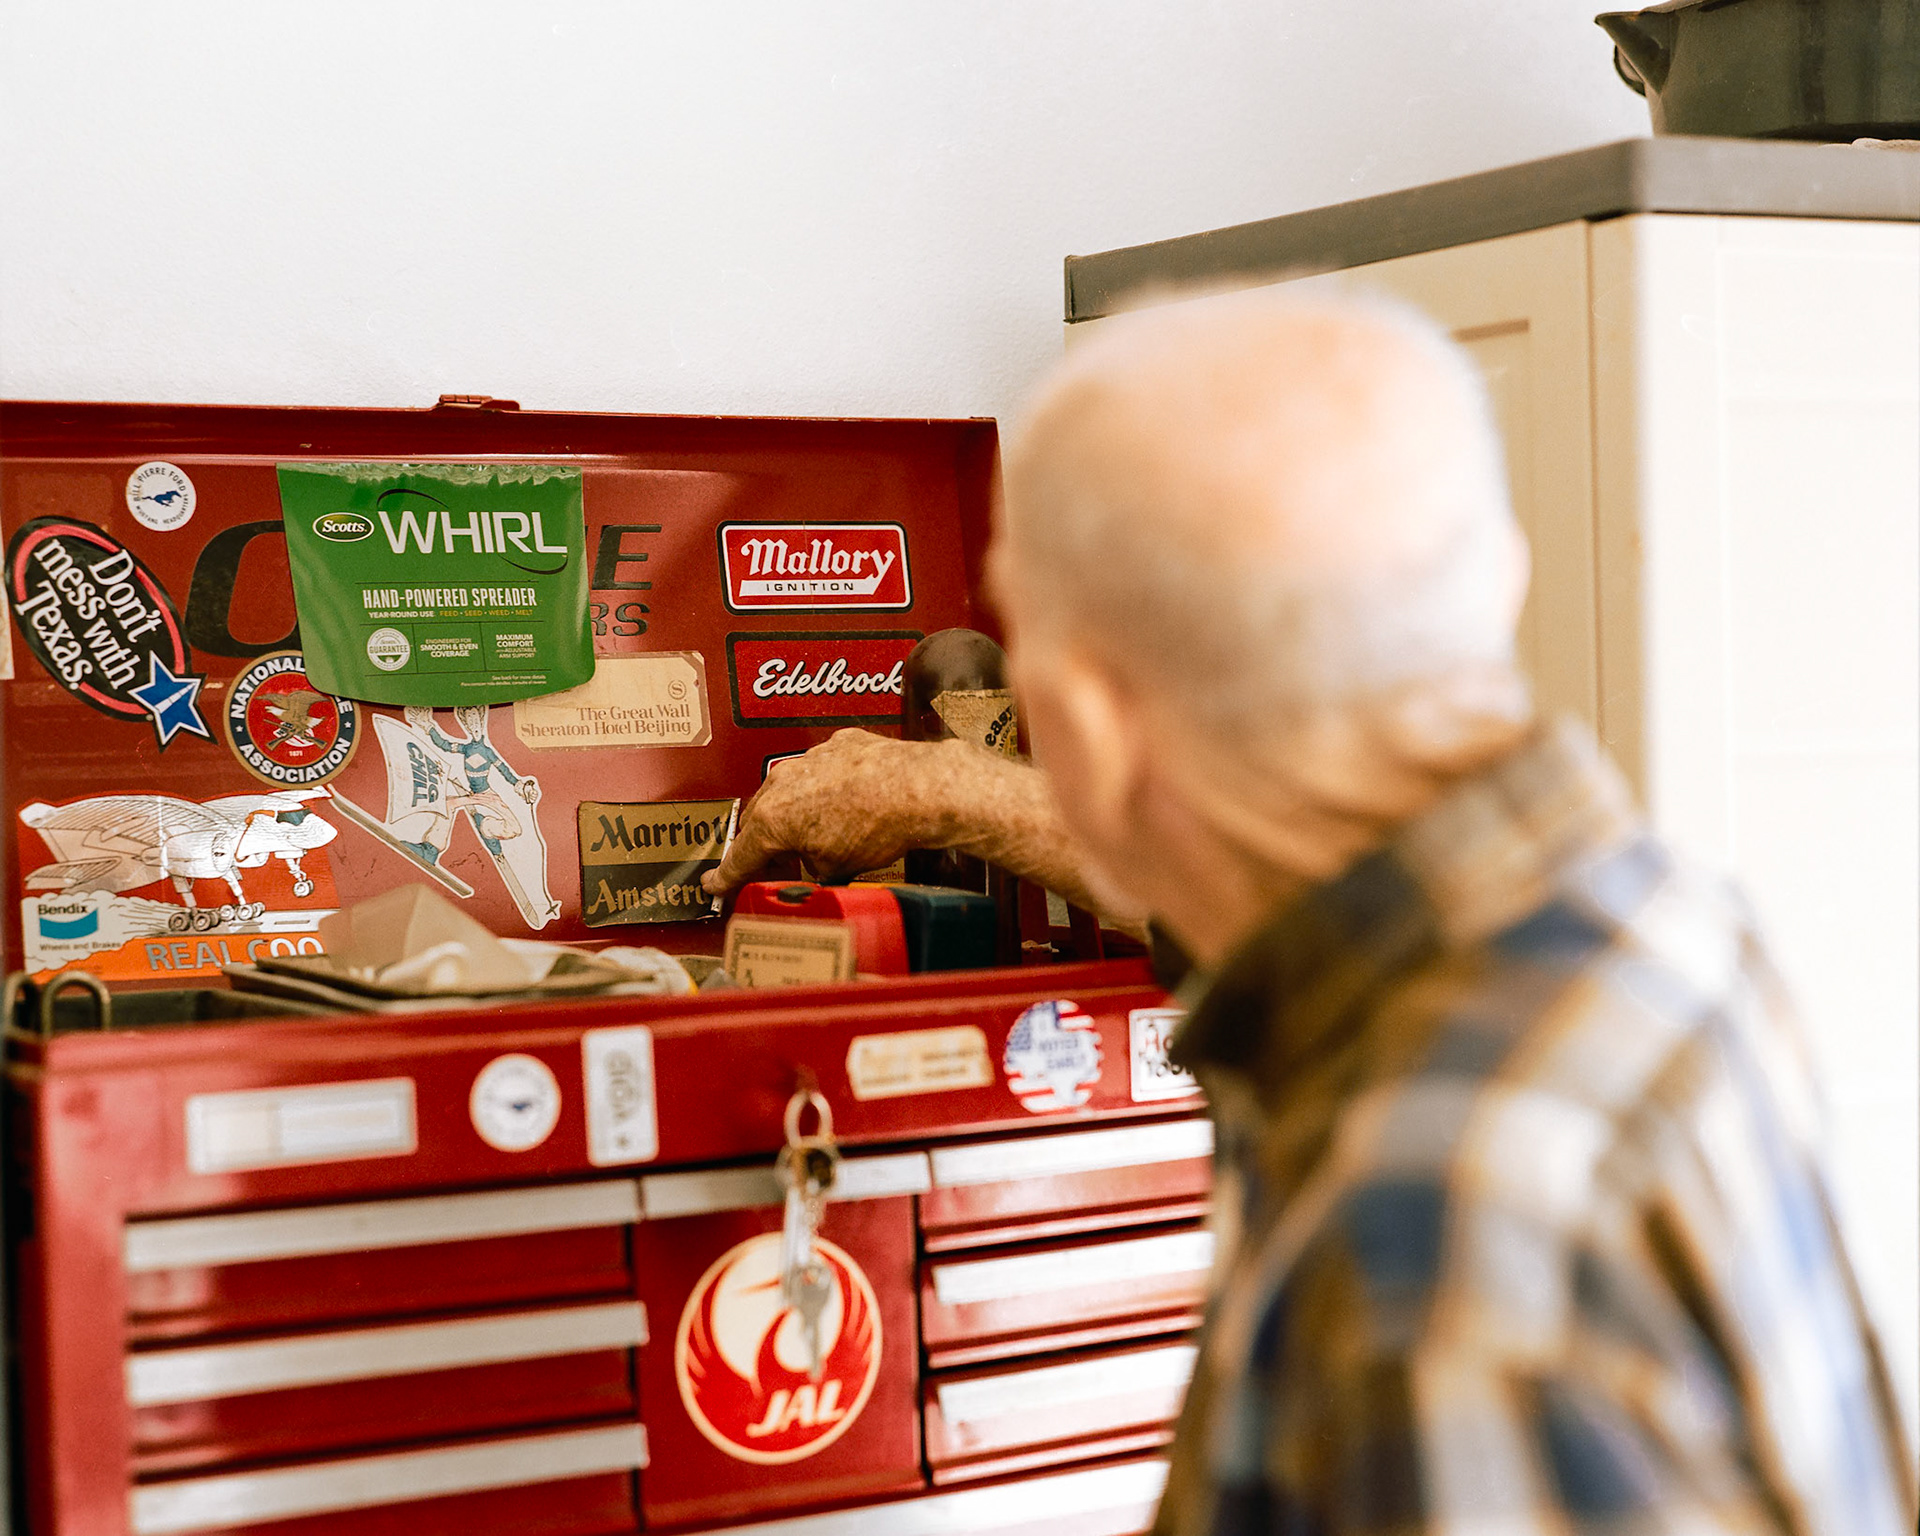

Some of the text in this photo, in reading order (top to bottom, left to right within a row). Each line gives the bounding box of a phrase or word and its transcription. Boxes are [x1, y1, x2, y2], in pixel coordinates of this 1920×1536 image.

[131, 467, 187, 502] BILL PIERRE FORD
[377, 511, 568, 554] WHIRL
[740, 538, 896, 580] Mallory
[88, 549, 163, 643] Don't
[362, 587, 538, 609] HAND-POWERED SPREADER
[766, 582, 854, 592] IGNITION
[33, 539, 141, 690] mess with
[368, 610, 435, 619] YEAR-ROUND USE
[15, 580, 93, 690] Texas.
[369, 644, 409, 654] GUARANTEE
[430, 650, 470, 658] COVERAGE
[230, 657, 305, 719] NATIONAL
[752, 657, 904, 698] Edelbrock
[521, 720, 691, 737] Sheraton Hotel Beijing
[576, 704, 690, 721] The Great Wall
[239, 737, 351, 782] ASSOCIATION
[406, 742, 428, 808] CHILL
[424, 754, 439, 803] BIG
[38, 903, 88, 916] Bendix
[40, 943, 71, 952] Wheels
[91, 941, 122, 949] Brakes
[145, 940, 242, 971] REAL
[745, 1379, 847, 1438] JAL
